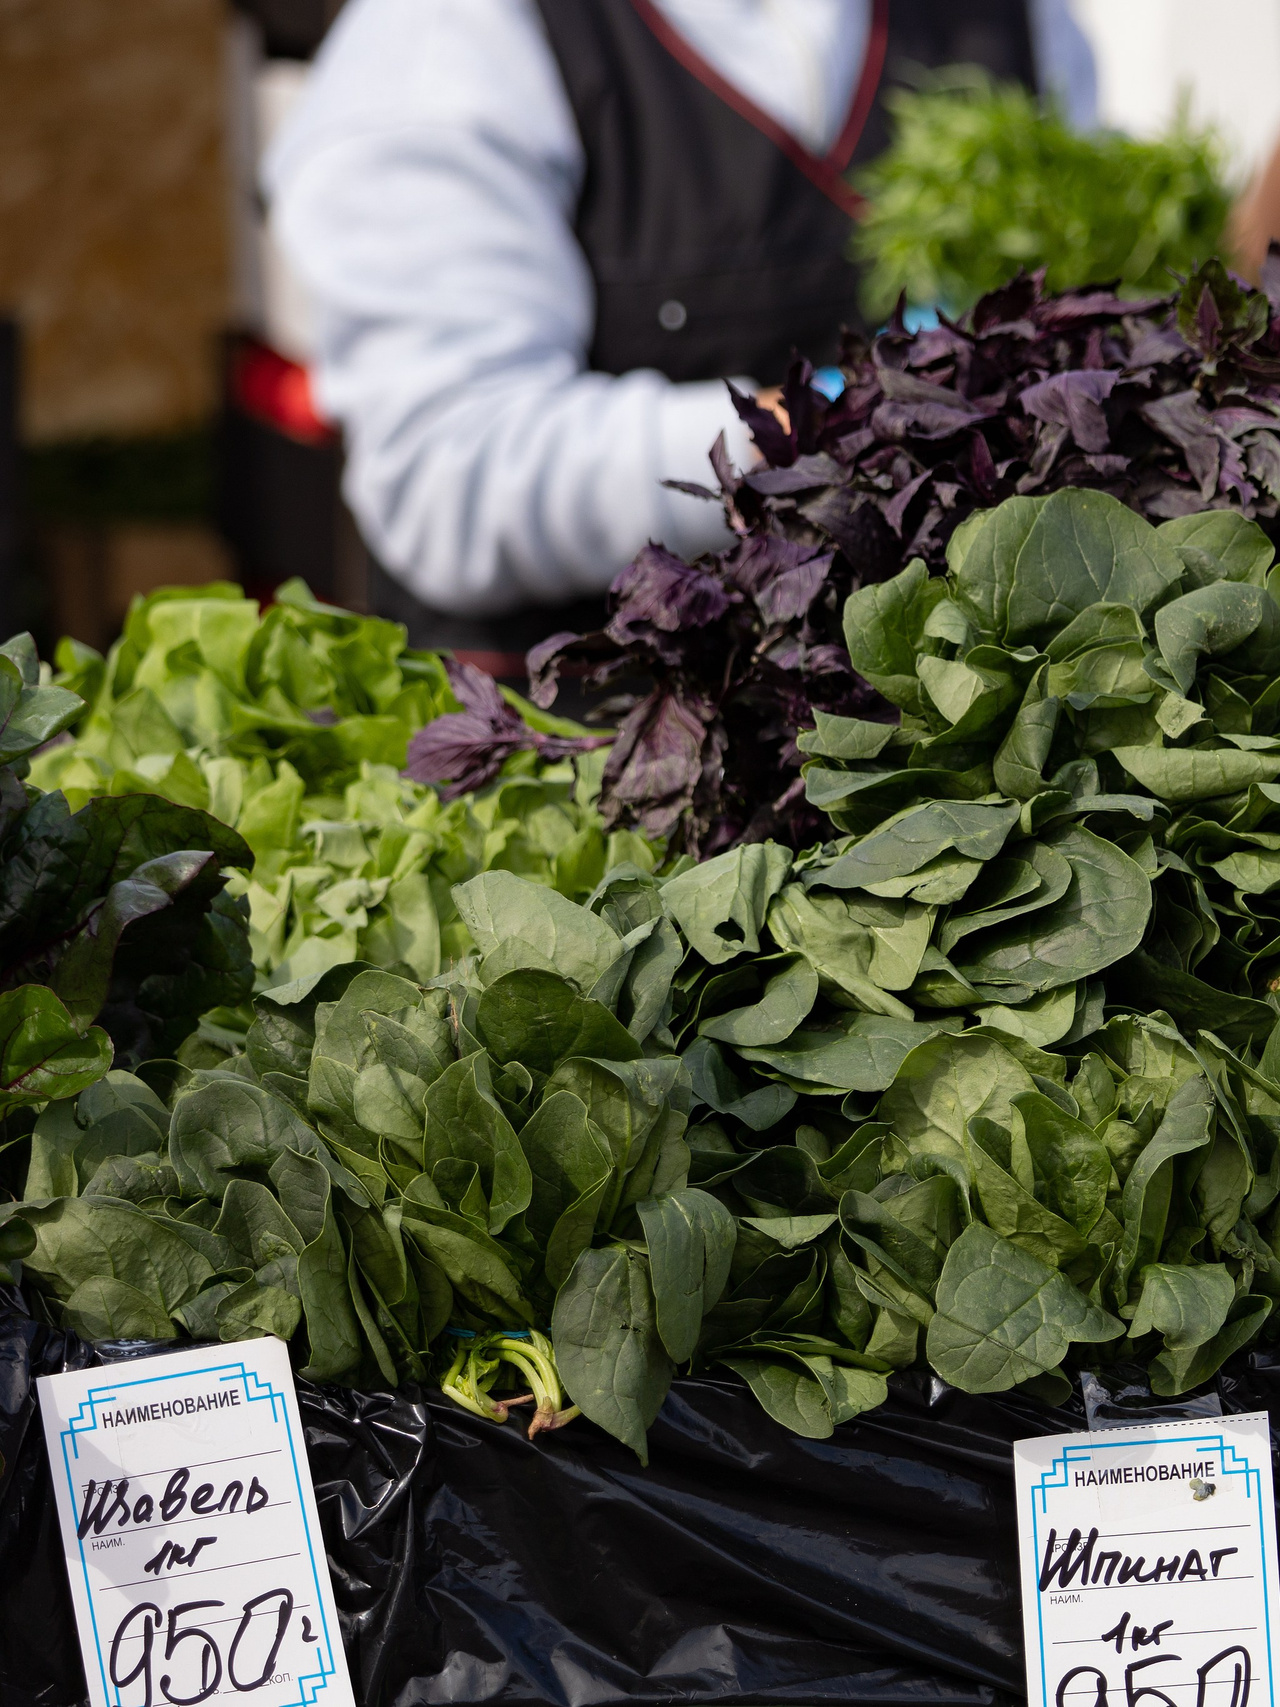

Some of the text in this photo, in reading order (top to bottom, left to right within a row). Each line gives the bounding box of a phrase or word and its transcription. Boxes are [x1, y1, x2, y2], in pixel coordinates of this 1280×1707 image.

[101, 1389, 242, 1429] НАИМЕНОВАНИЕ
[1074, 1461, 1216, 1488] НАИМЕНОВАНИЕ
[91, 1537, 126, 1552] НАИМ.
[1038, 1527, 1239, 1592] Шпинат
[1050, 1594, 1084, 1605] НАИМ.
[109, 1587, 294, 1707] 950
[1101, 1611, 1174, 1653] 1кг
[268, 1672, 294, 1686] КОП.
